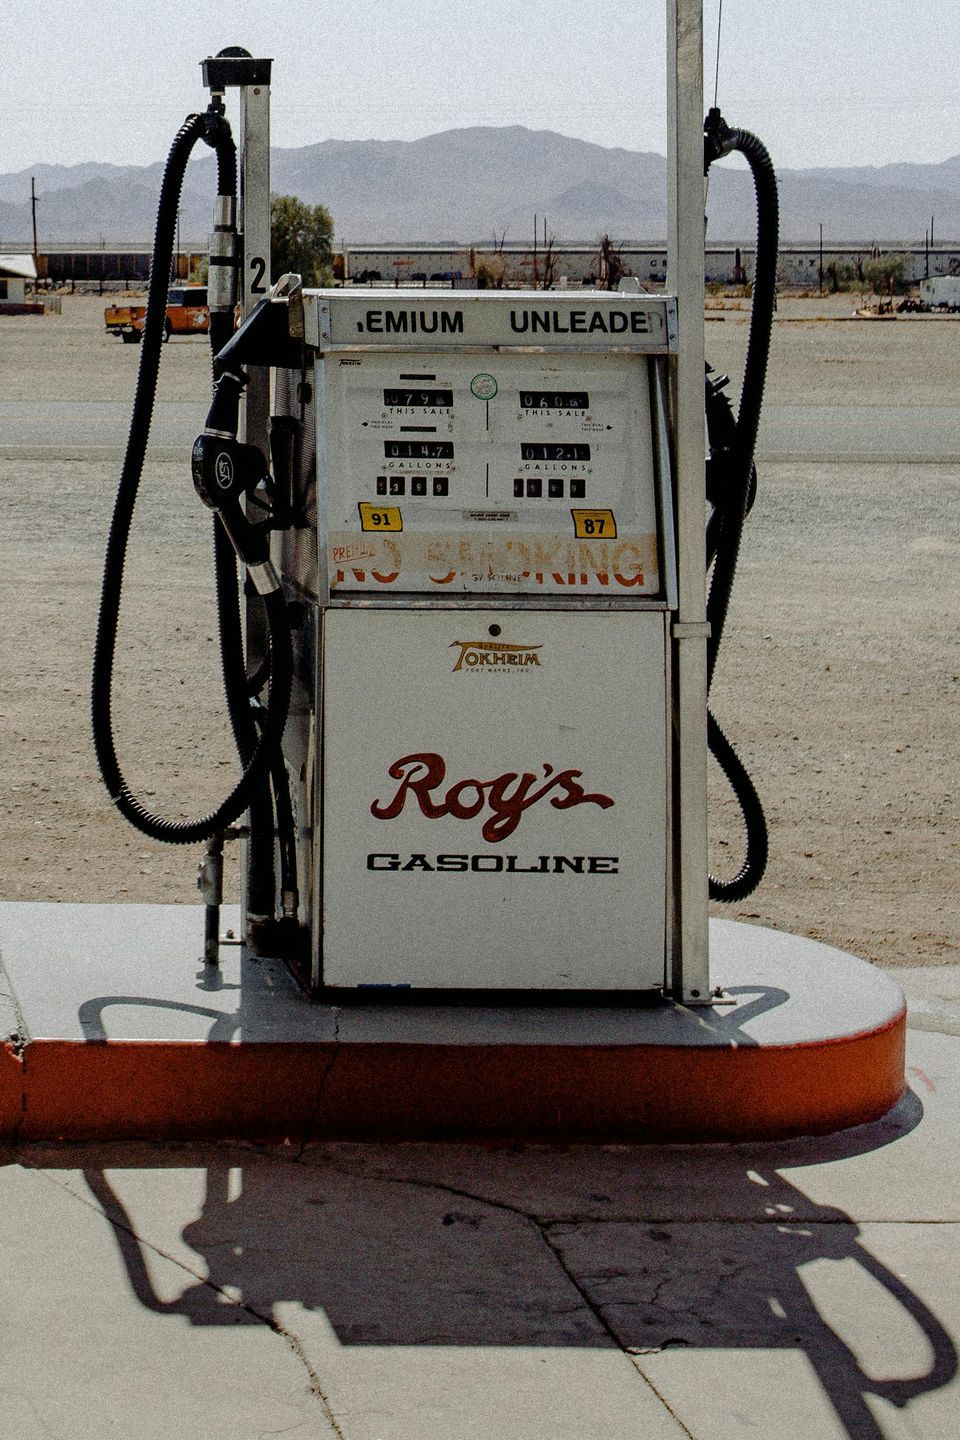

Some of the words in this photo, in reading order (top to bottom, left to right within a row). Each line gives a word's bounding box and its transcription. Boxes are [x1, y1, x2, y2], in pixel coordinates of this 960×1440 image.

[250, 257, 266, 294] 2
[220, 460, 230, 483] VST
[371, 513, 391, 526] 91
[583, 518, 605, 535] 87
[449, 641, 543, 673] TOKHEIM
[370, 752, 615, 843] Roy's
[366, 853, 619, 875] GASOLINE
